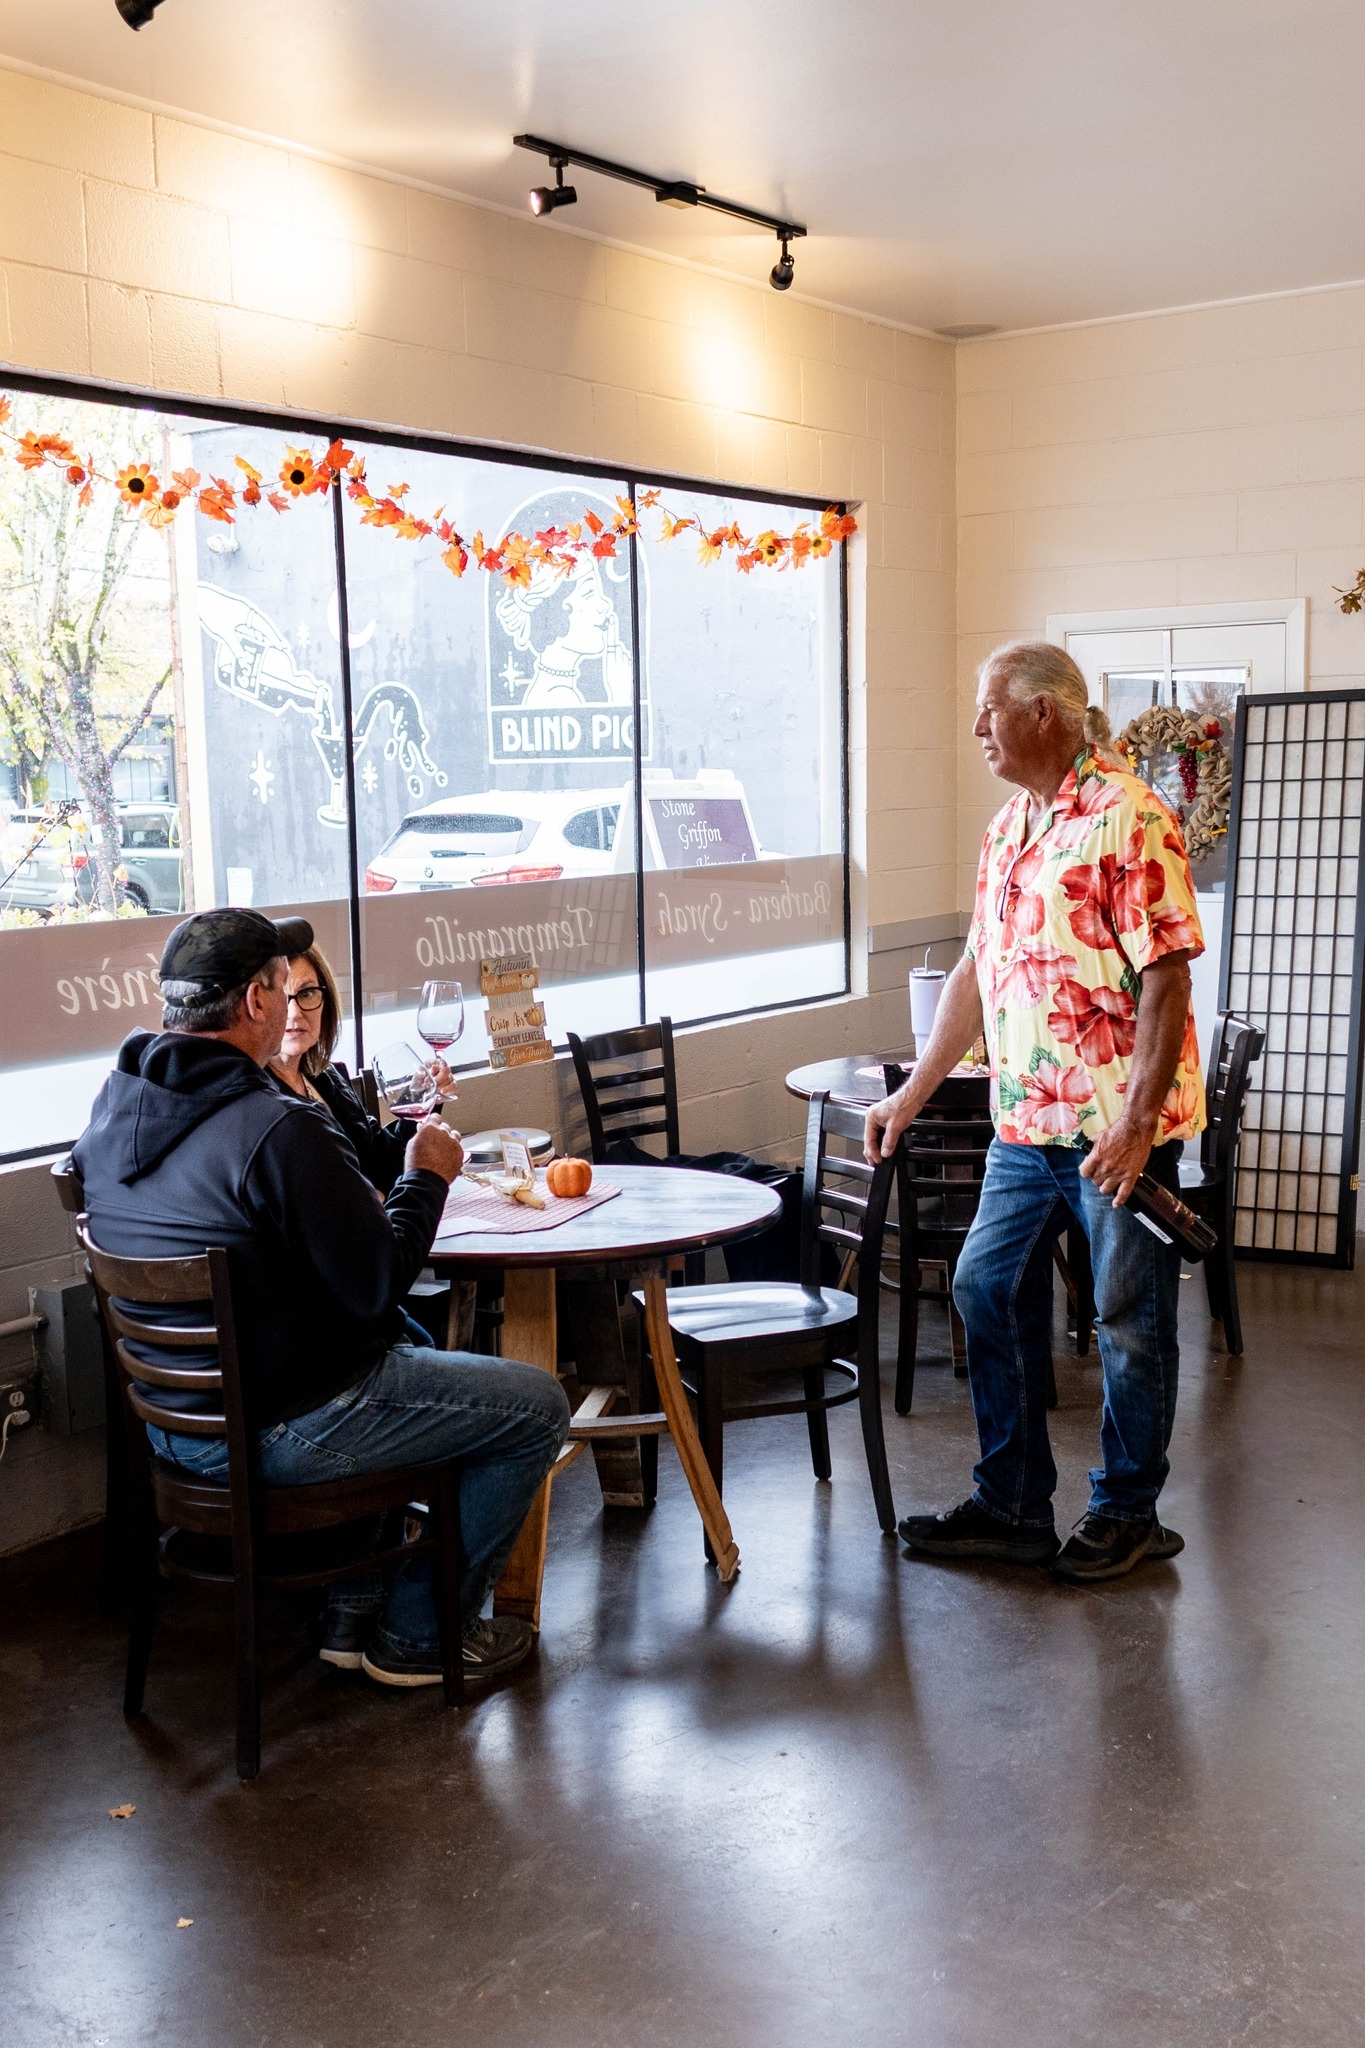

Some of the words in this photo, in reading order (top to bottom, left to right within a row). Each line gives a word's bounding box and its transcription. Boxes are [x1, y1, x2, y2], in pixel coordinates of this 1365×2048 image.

[502, 715, 582, 751] BLIND
[661, 800, 696, 818] Stone
[678, 820, 723, 850] Griffon
[490, 959, 531, 975] Autumn
[490, 1015, 509, 1033] Crisp
[513, 1012, 525, 1028] Air
[498, 1033, 522, 1048] CRUNCHY
[521, 1030, 540, 1044] LEAVES
[509, 1047, 525, 1065] Give
[526, 1043, 553, 1058] Thanks
